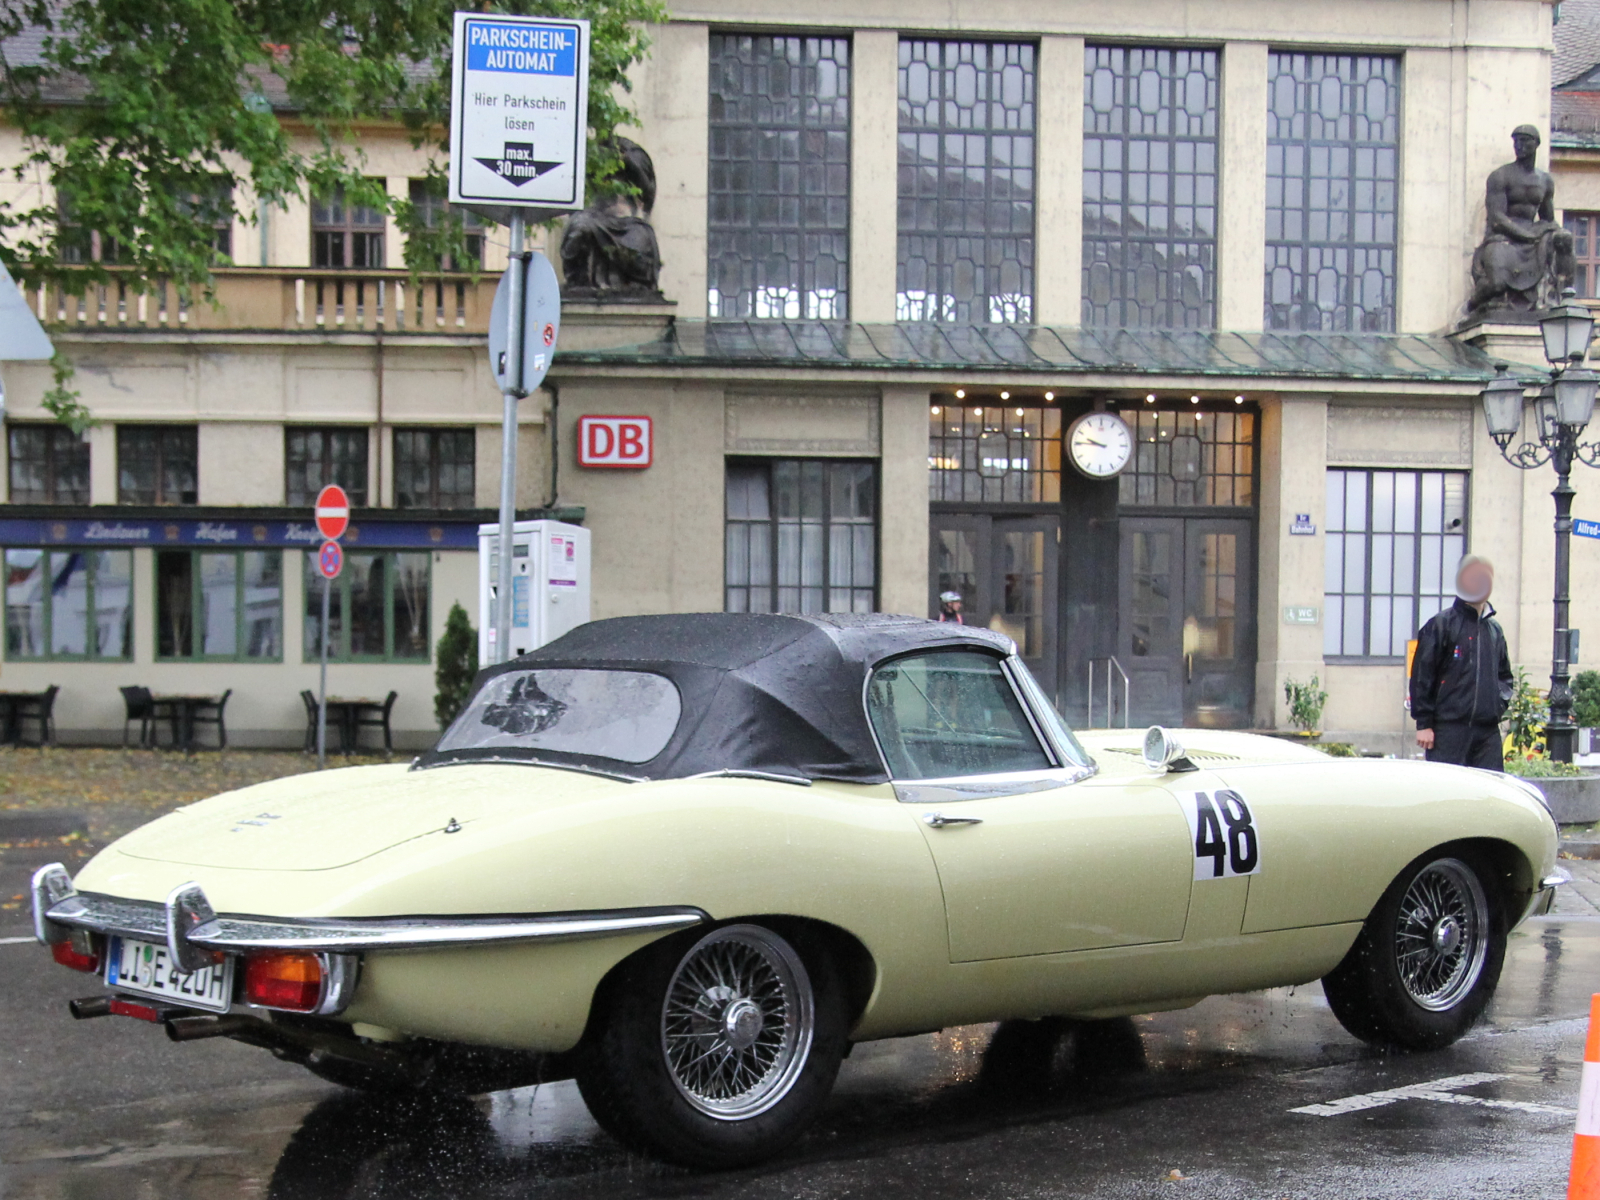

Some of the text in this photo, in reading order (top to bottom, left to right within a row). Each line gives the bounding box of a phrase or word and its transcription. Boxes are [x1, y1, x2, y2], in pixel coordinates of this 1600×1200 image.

[471, 27, 572, 51] PARKSCHEIN-
[486, 50, 557, 71] AUTOMAT
[474, 92, 566, 111] Hier Parkschein
[504, 116, 535, 131] lösen
[505, 148, 533, 161] max.
[496, 162, 540, 177] 30 min.
[589, 424, 644, 458] DB
[1195, 789, 1257, 877] 48
